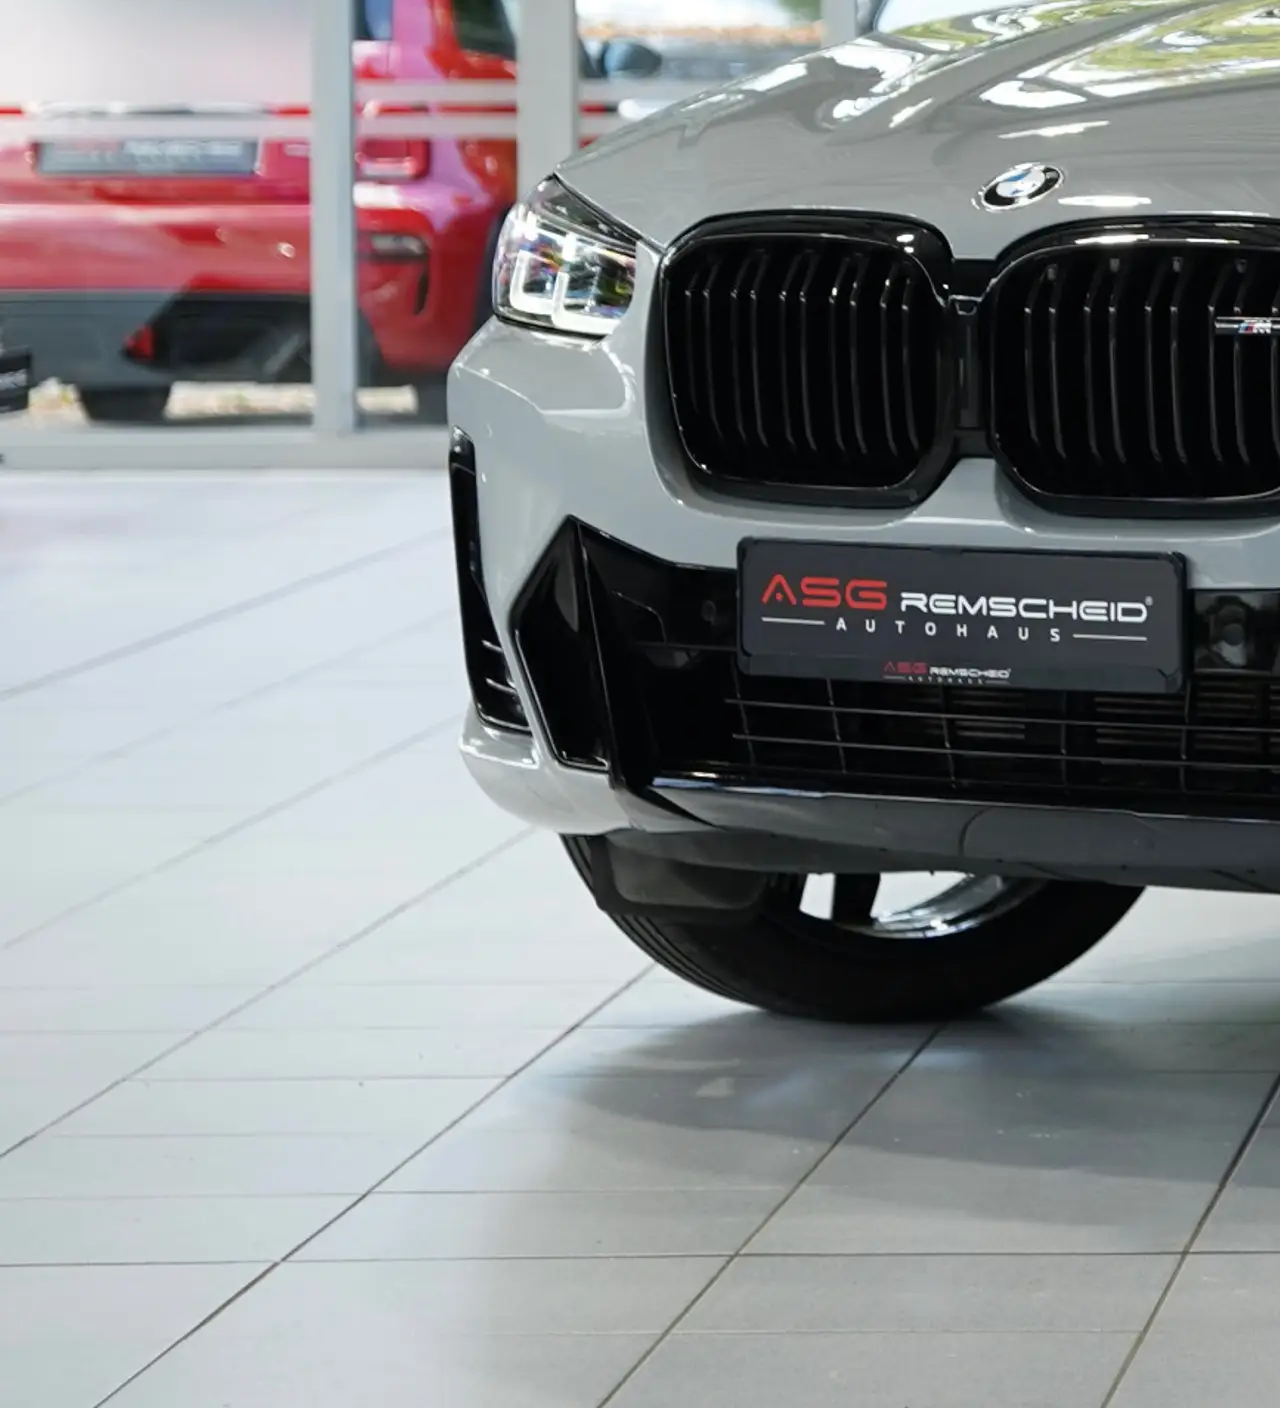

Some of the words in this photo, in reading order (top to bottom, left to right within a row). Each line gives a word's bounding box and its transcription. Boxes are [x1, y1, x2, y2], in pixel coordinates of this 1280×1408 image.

[761, 574, 888, 611] ASG
[901, 592, 1148, 624] REMSCHEID
[836, 618, 1062, 643] AUTOHAUS
